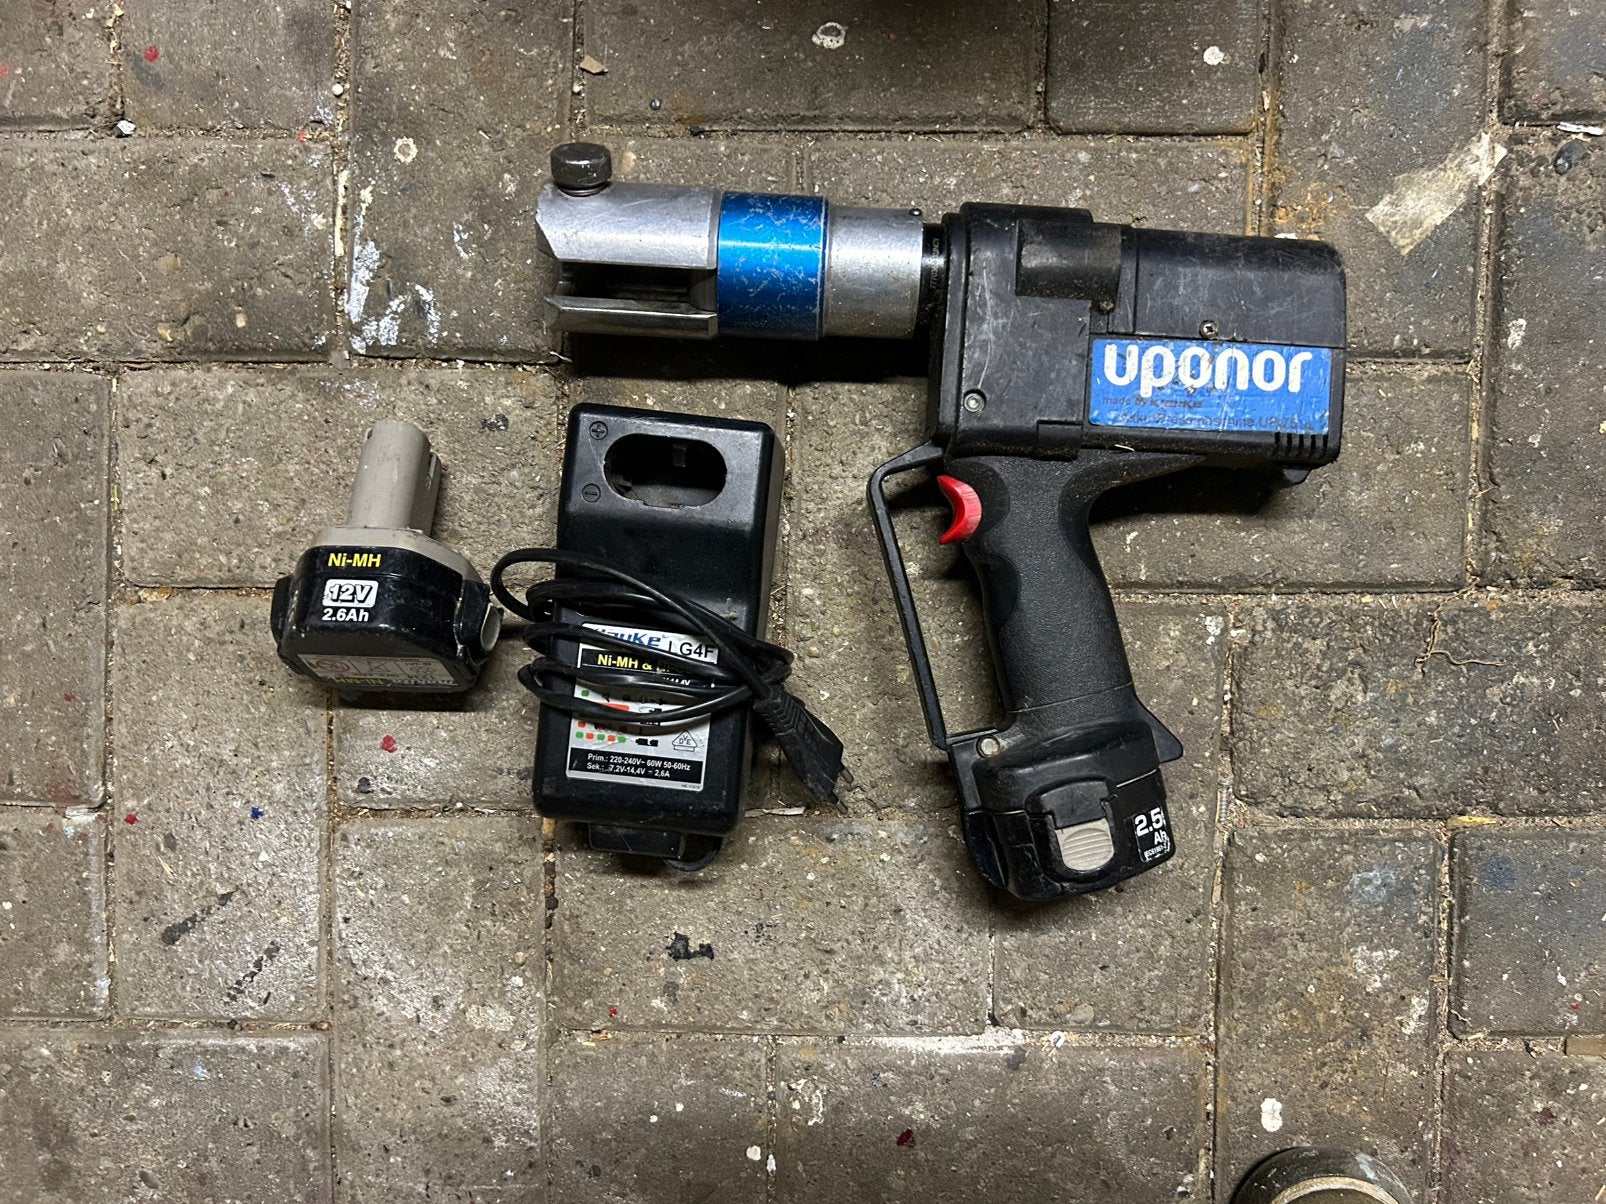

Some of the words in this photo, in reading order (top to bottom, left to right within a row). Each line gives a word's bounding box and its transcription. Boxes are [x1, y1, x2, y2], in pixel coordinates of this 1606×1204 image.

[1103, 344, 1313, 398] uponor
[327, 552, 382, 568] Ni-MH
[329, 583, 374, 604] 12V
[321, 607, 370, 622] 2.6Ah
[597, 653, 639, 669] Ni-MH
[646, 759, 663, 768] 60W
[663, 761, 691, 771] 50-60Hz
[654, 769, 670, 778] 2,6A
[1134, 806, 1163, 837] 2.5
